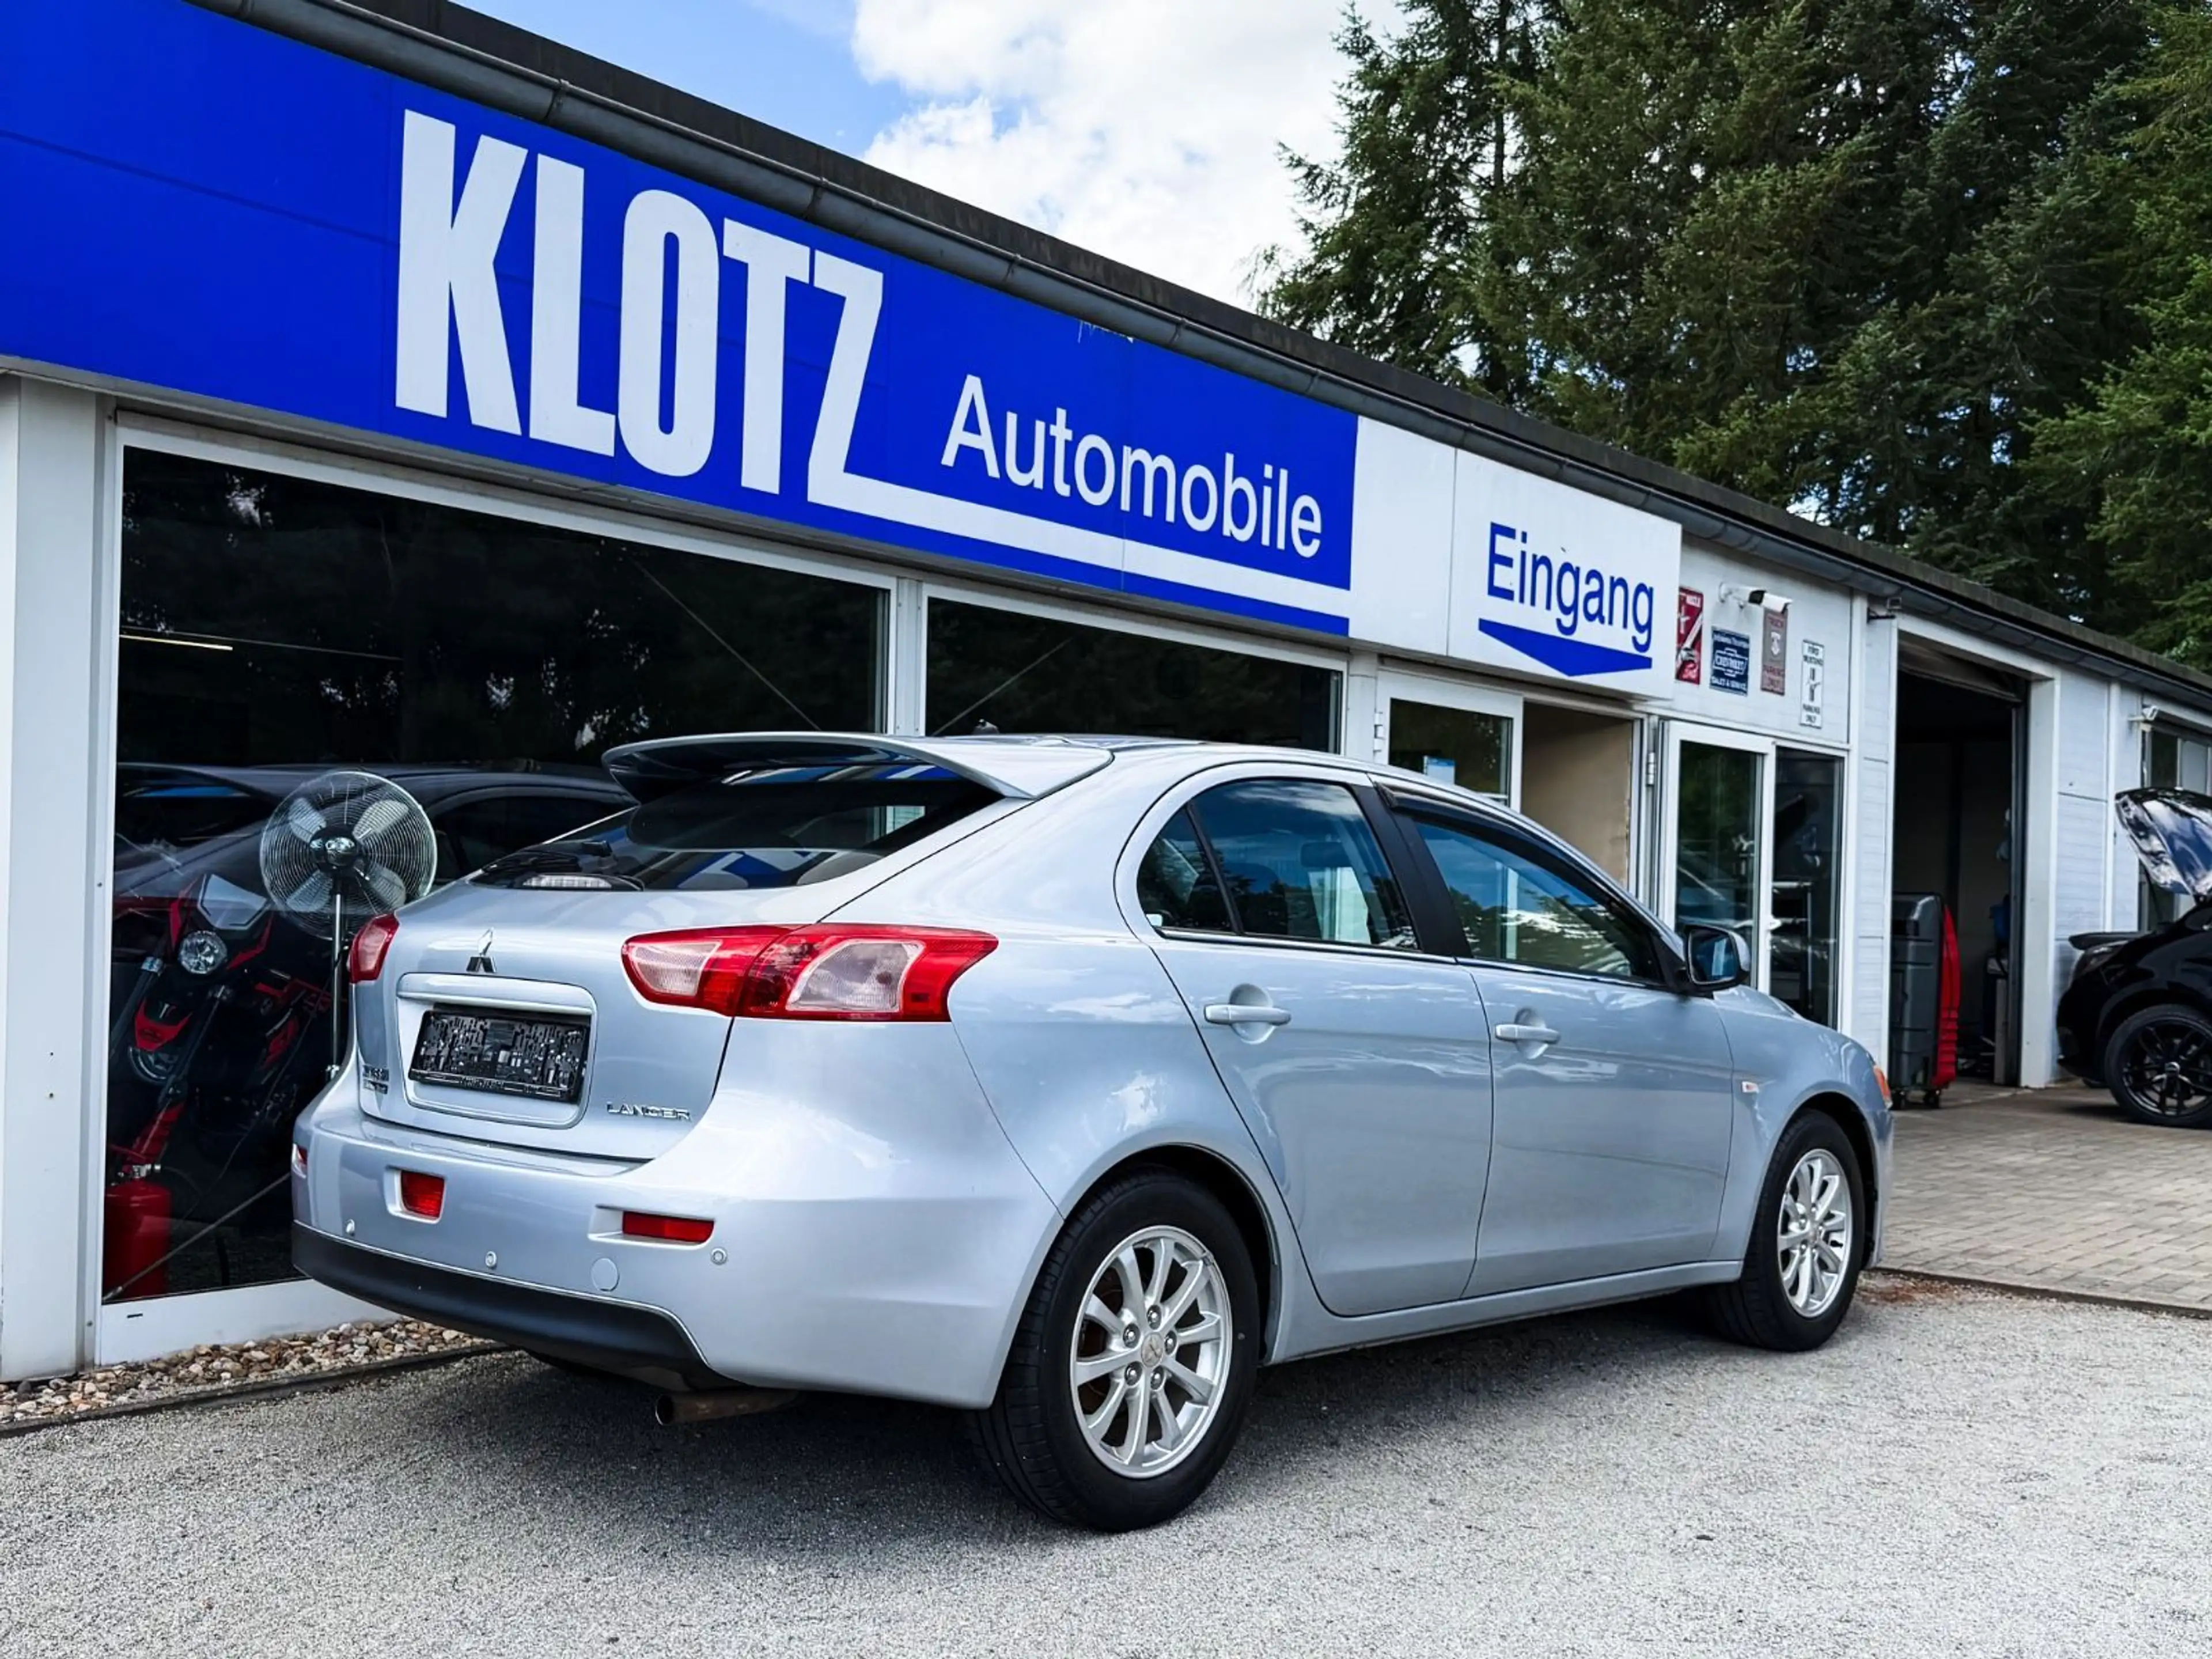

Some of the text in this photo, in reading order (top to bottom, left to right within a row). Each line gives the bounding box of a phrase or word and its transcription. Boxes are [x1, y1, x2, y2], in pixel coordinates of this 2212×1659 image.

[395, 109, 884, 502] KLOTZ
[941, 374, 1321, 558] Automobile
[1487, 521, 1654, 653] Eingang
[606, 1101, 692, 1123] LANCER
